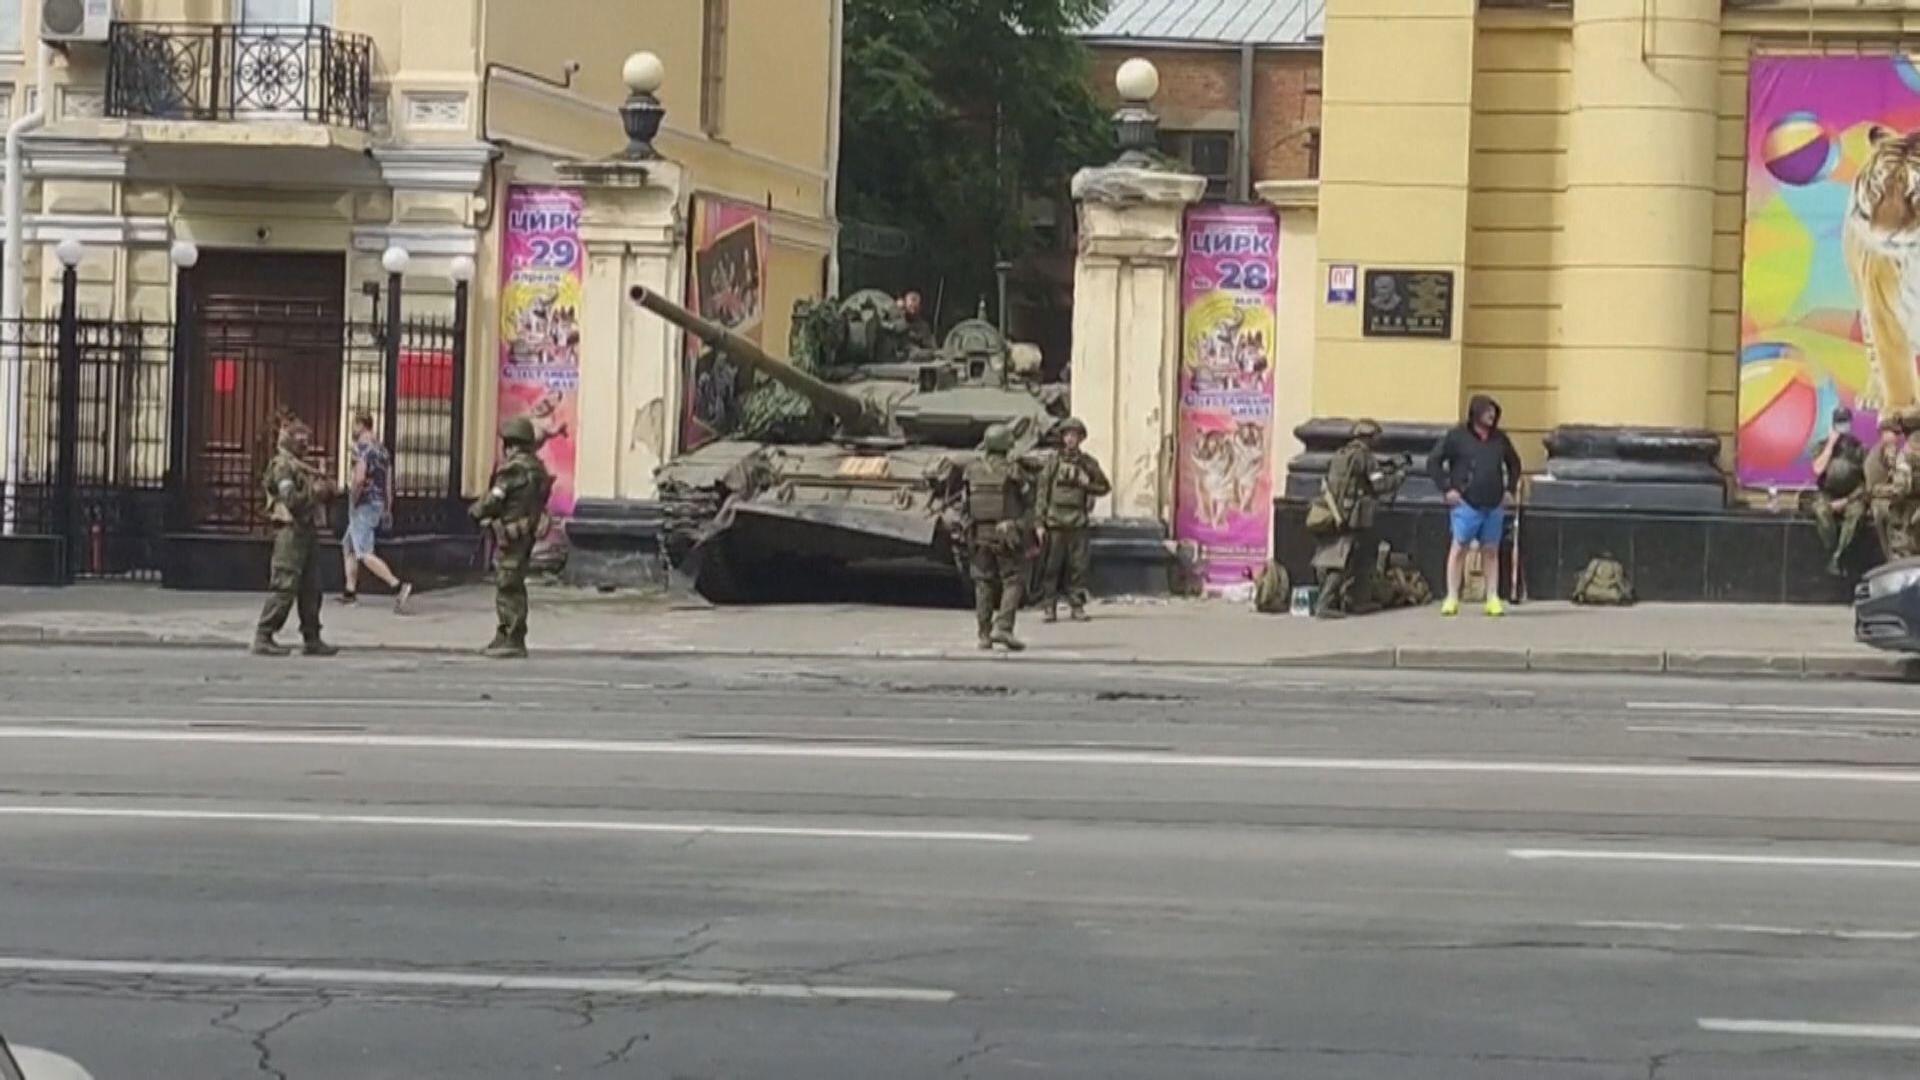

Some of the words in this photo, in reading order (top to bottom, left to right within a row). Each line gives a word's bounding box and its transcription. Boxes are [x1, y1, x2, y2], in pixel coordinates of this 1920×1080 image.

[510, 211, 578, 233] ЦИРК
[529, 238, 576, 267] 29
[1192, 232, 1270, 254] ЦИРК
[1218, 262, 1268, 290] 28
